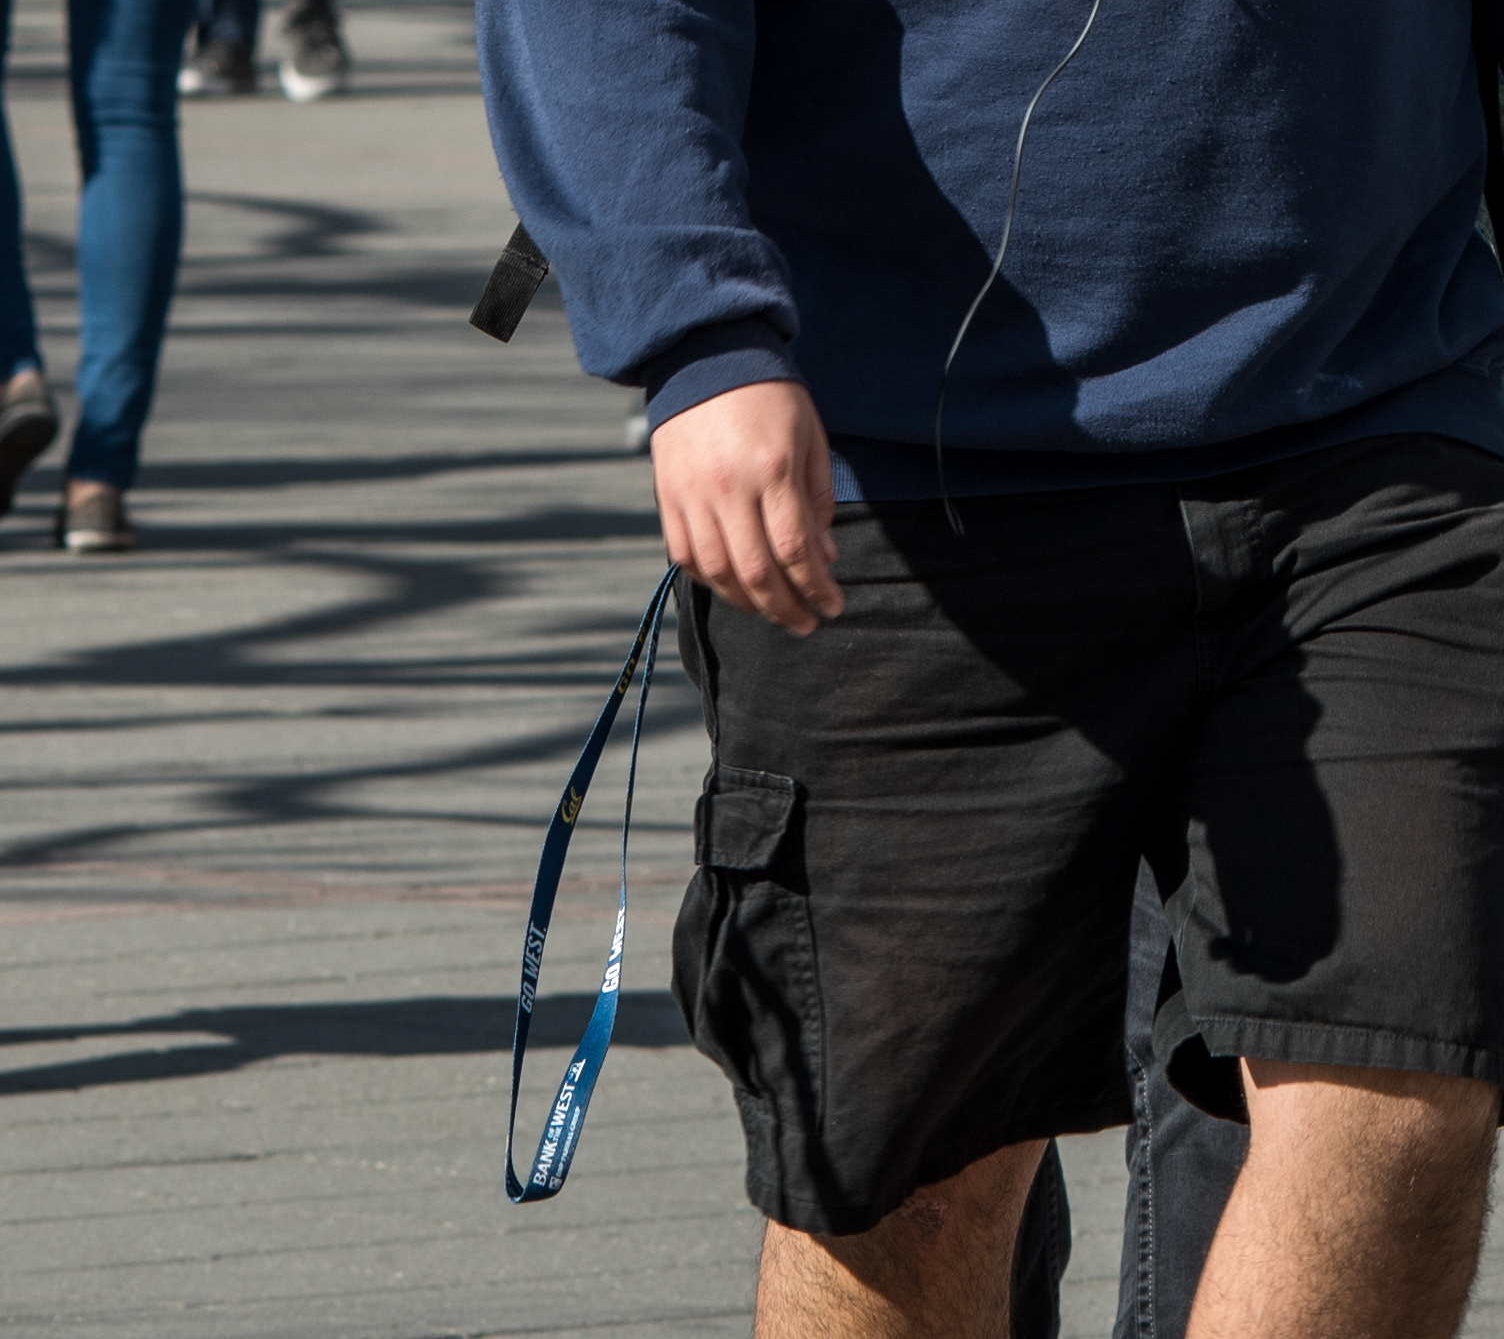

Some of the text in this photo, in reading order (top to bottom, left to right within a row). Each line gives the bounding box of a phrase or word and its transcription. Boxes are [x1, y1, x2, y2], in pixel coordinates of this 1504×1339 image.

[561, 786, 582, 827] Cal
[601, 962, 621, 994] GO
[521, 980, 535, 1014] GO
[532, 1138, 559, 1187] BANK
[550, 1081, 576, 1128] WEST
